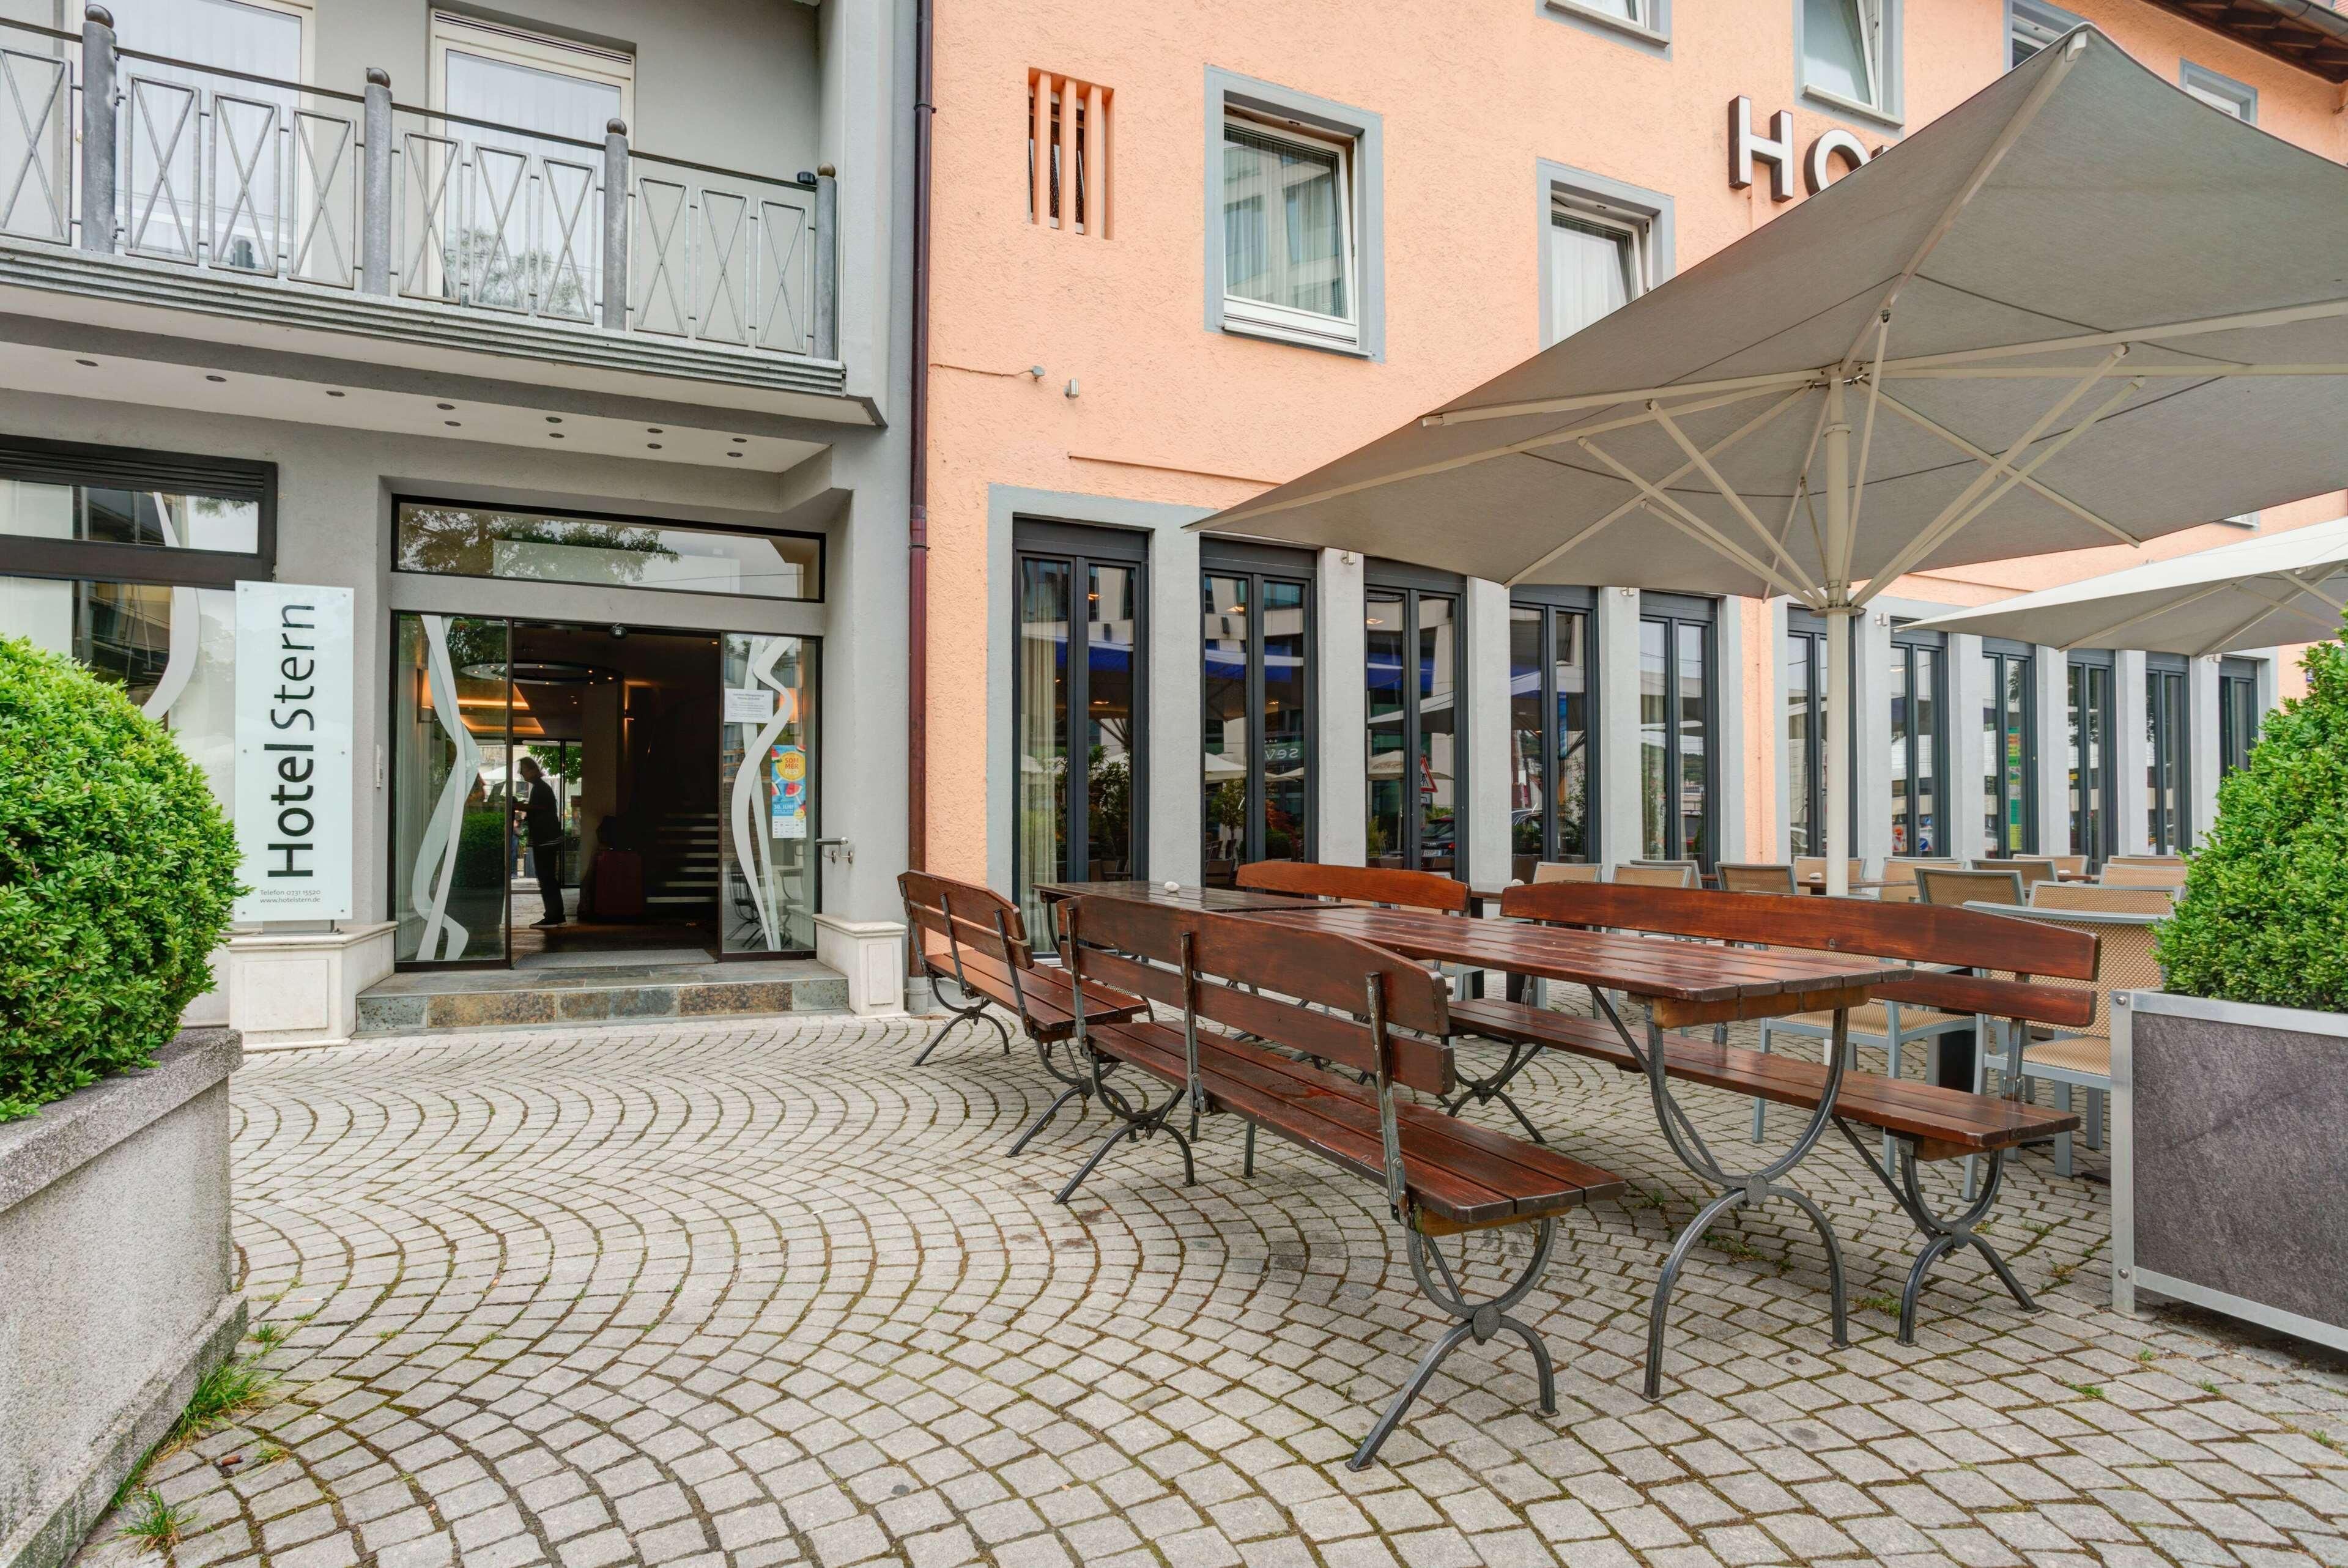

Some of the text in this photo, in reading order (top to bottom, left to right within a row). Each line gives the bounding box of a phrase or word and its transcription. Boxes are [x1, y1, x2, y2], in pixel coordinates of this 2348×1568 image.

[1728, 95, 1891, 203] HO
[264, 605, 315, 878] Hotel Stern
